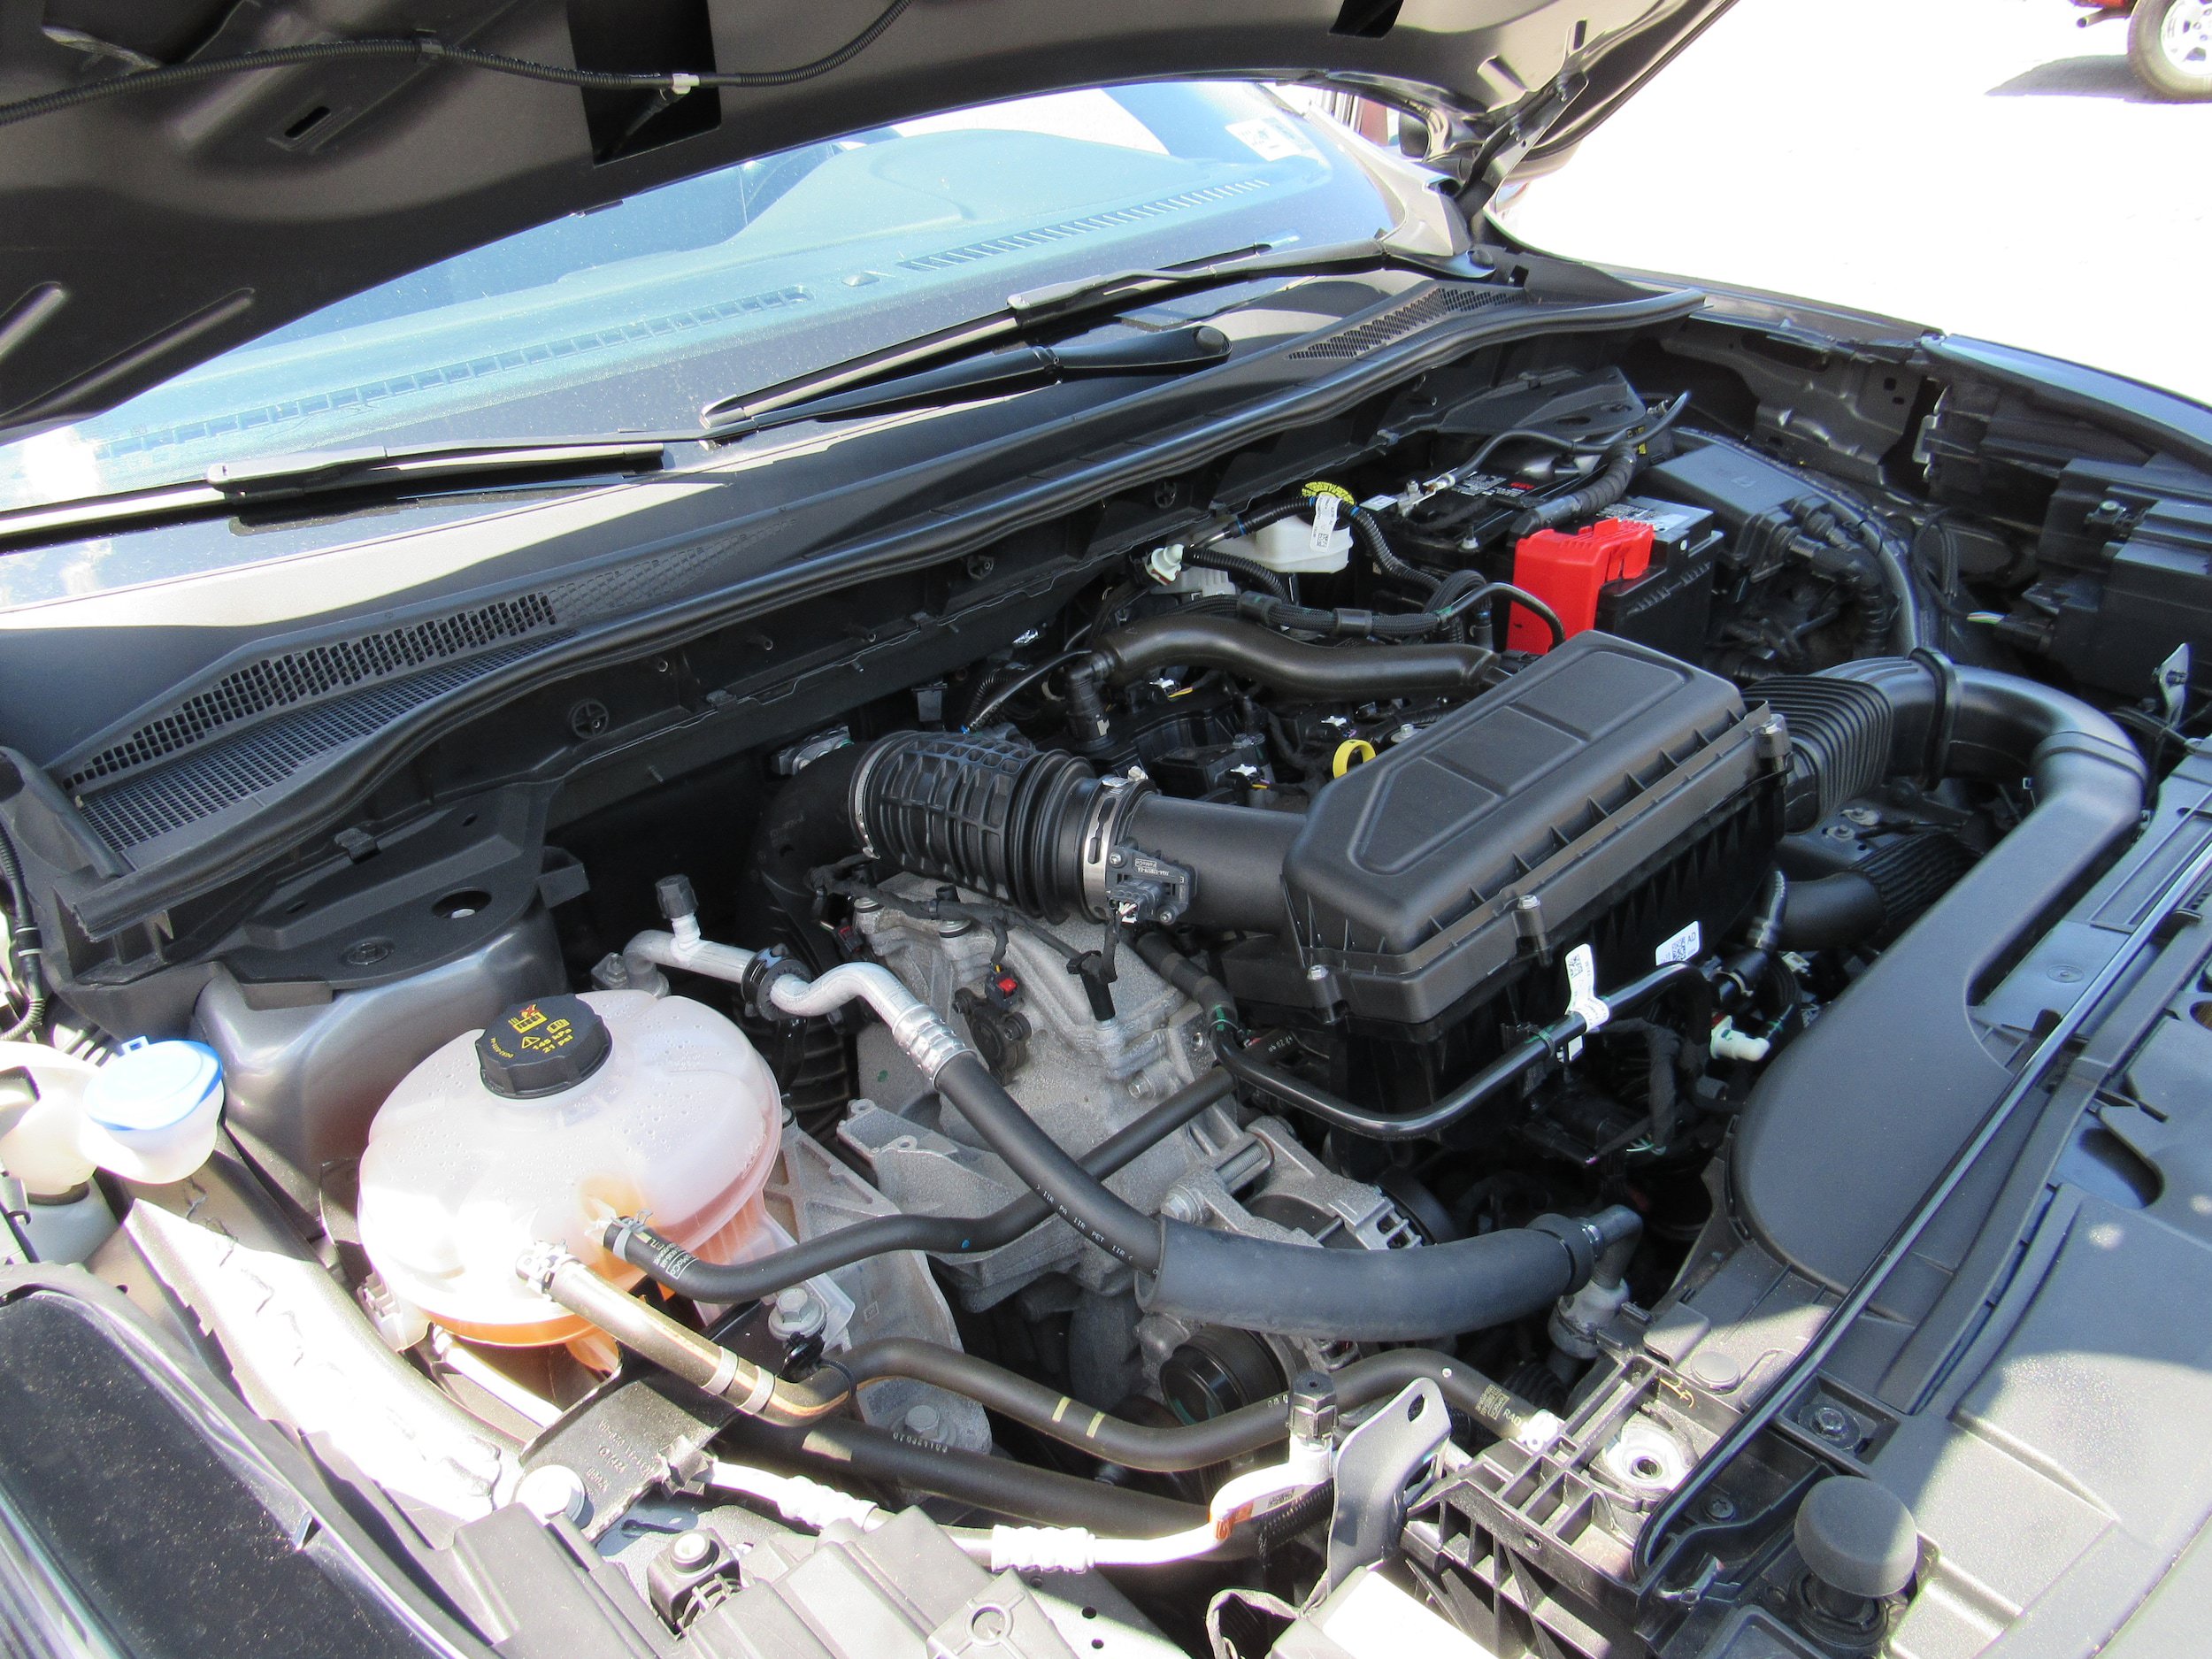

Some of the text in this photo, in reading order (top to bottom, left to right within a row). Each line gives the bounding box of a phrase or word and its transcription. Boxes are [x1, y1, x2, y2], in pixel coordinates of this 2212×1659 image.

[1687, 932, 1696, 943] AD
[533, 1028, 573, 1050] 145 kPa
[543, 1034, 573, 1054] 21 psi
[1042, 1190, 1055, 1203] IIR
[1058, 1204, 1068, 1215] PA
[1073, 1217, 1087, 1230] IIR
[1091, 1231, 1105, 1242] PET
[1111, 1245, 1125, 1257] IIR
[1503, 1409, 1522, 1426] RAD
